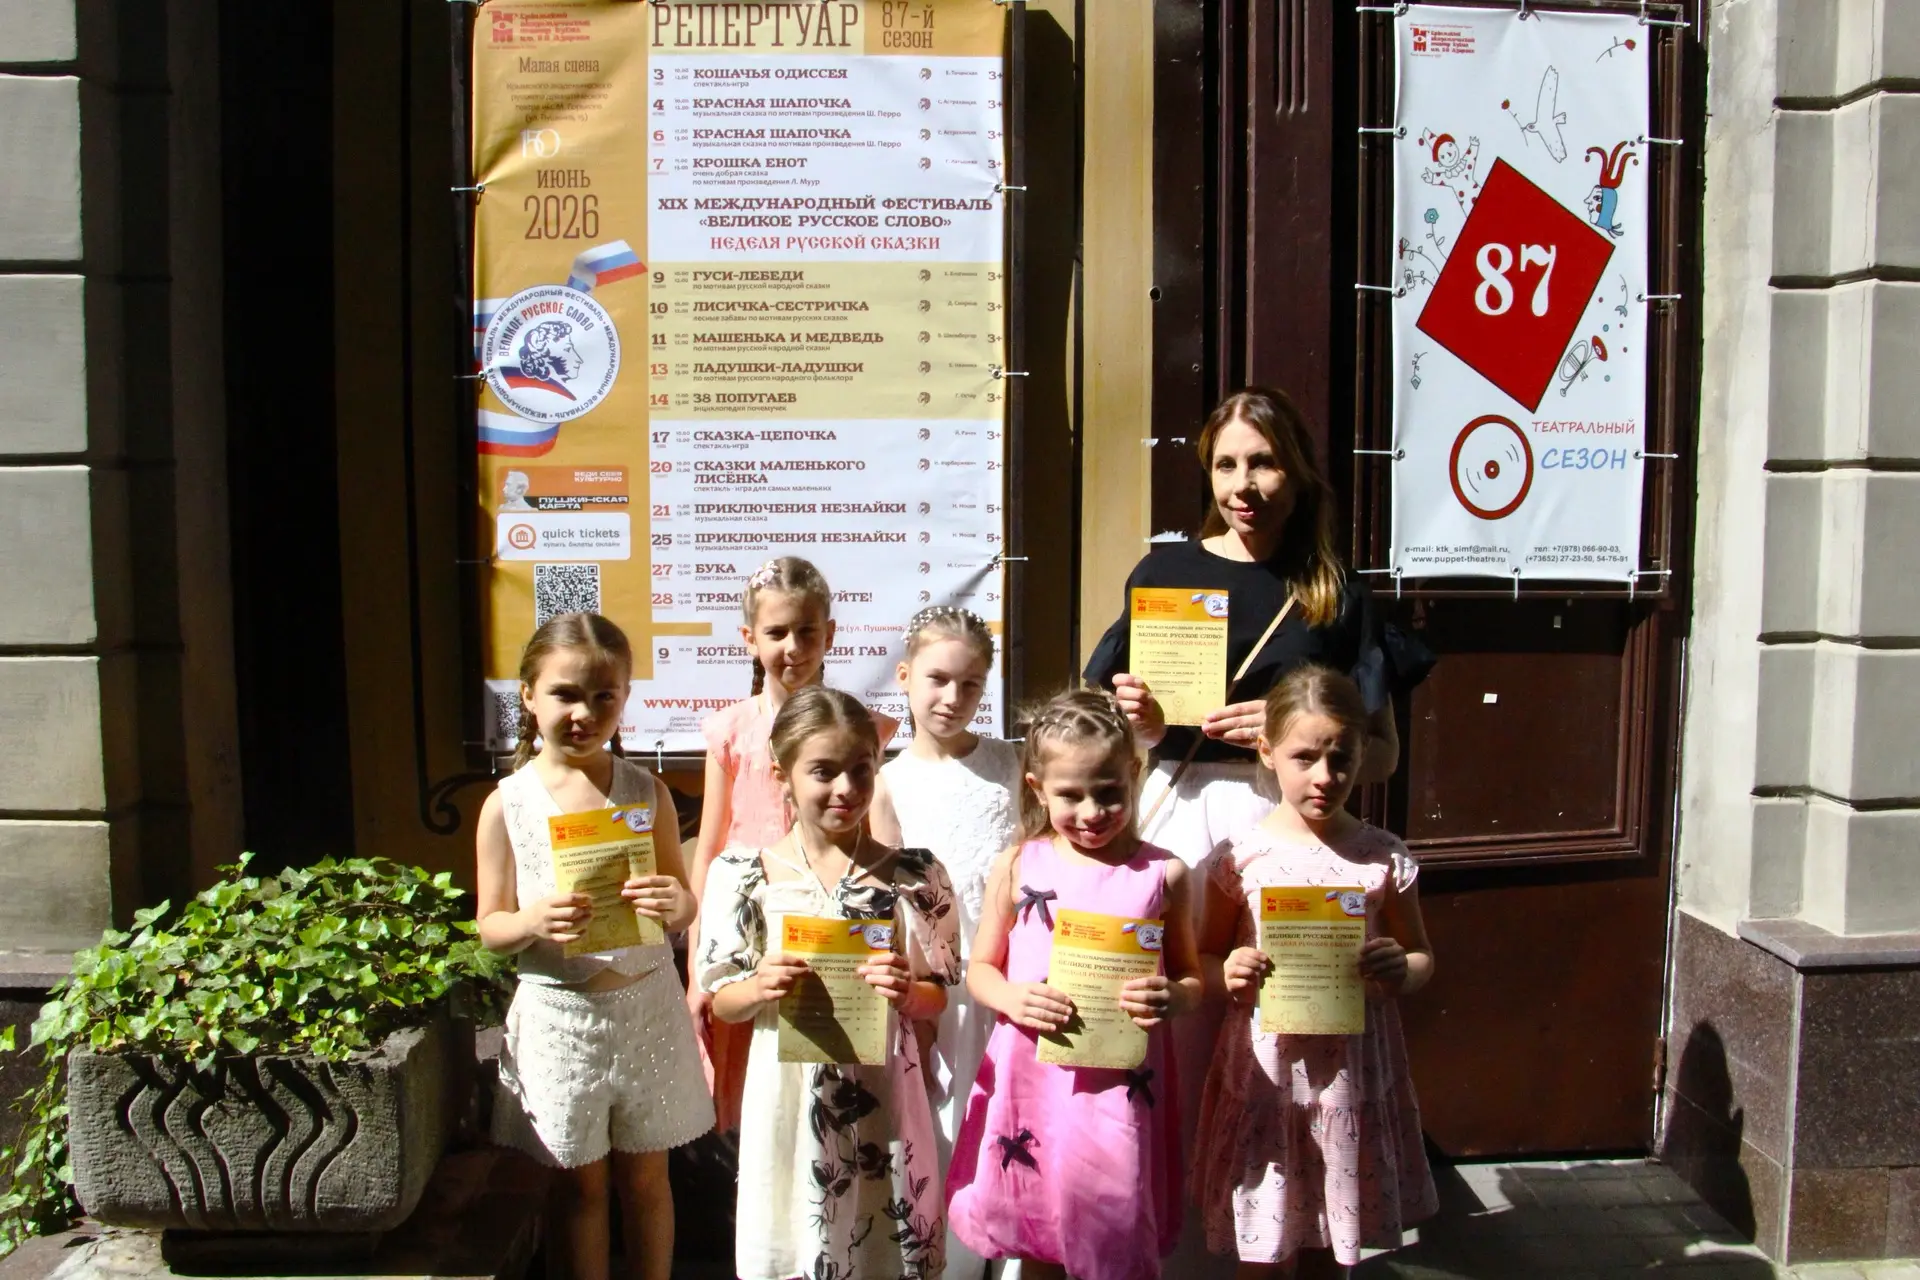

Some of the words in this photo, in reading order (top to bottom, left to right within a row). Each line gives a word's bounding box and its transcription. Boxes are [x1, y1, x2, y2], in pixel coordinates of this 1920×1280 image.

[882, 1, 934, 28] 87-й
[652, 4, 858, 46] РЕПЕРТУАР
[883, 30, 933, 48] сезон
[520, 57, 560, 73] Малая
[564, 59, 600, 75] сцена
[654, 69, 664, 80] 3
[694, 69, 771, 79] КОШАЧЬЯ
[775, 69, 848, 79] ОДИССЕЯ
[989, 71, 1003, 80] 3+
[694, 80, 749, 88] спектакль-игра
[653, 99, 665, 110] 4
[693, 98, 765, 108] КРАСНАЯ
[770, 98, 851, 108] ШАПОЧКА
[988, 100, 1003, 109] 3+
[653, 130, 665, 141] 6
[693, 129, 765, 139] КРАСНАЯ
[770, 129, 851, 139] ШАПОЧКА
[988, 130, 1003, 140] 3+
[654, 158, 664, 170] 7
[693, 158, 761, 168] КРОШКА
[766, 158, 807, 168] ЕНОТ
[988, 160, 1002, 169] 3+
[537, 170, 591, 188] ИЮНЬ
[716, 170, 743, 178] добрая
[800, 178, 820, 186] Муур
[658, 198, 688, 210] XIX
[694, 195, 875, 211] МЕЖДУНАРОДНЫЙ
[882, 198, 993, 211] ФЕСТИВАЛЬ
[524, 194, 599, 240] 2026
[700, 216, 792, 227] «ВЕЛИКОЕ
[798, 216, 879, 227] РУССКОЕ
[885, 216, 952, 227] СЛОВО»
[711, 236, 780, 251] НЕДЕЛЯ
[786, 235, 866, 253] РУССКОЙ
[871, 236, 940, 250] СКАЗКИ
[653, 272, 665, 283] 9
[693, 272, 804, 282] ГУСИ-ЛЕБЕДИ
[988, 272, 1003, 281] 3+
[1474, 243, 1556, 317] 87
[499, 289, 563, 322] МЕЖДУНАРОДНЫЙ
[565, 291, 604, 322] ФЕСТИВАЛЬ
[650, 302, 668, 314] 10
[693, 302, 869, 311] ЛИСИЧКА-СЕСТРИЧКА
[988, 302, 1002, 312] 3+
[499, 316, 524, 356] ВЕЛИКОЕ
[521, 302, 564, 321] РУССКОЕ
[566, 306, 595, 332] СЛОВО
[652, 334, 667, 345] 11
[694, 333, 786, 343] МАШЕНЬКА
[790, 333, 801, 343] И
[806, 333, 884, 343] МЕДВЕДЬ
[988, 334, 1002, 343] 3+
[599, 326, 616, 396] МЕЖДУНАРОДНЫЙ
[650, 364, 668, 375] 13
[694, 363, 863, 373] ЛАДУШКИ-ЛАДУШКИ
[694, 375, 702, 383] по
[704, 375, 736, 383] мотивам
[738, 375, 770, 383] русского
[772, 375, 811, 383] народного
[813, 375, 853, 383] фольклора
[650, 394, 669, 405] 14
[693, 394, 711, 403] 38
[716, 394, 797, 403] ПОПУГАЕВ
[987, 394, 1002, 403] 3+
[555, 394, 599, 418] ФЕСТИВАЛЬ
[1532, 418, 1635, 434] ТЕАТРАЛЬНЫЙ
[652, 432, 670, 443] 17
[694, 431, 836, 442] СКАЗКА-ЦЕПОЧКА
[987, 431, 1001, 440] 3+
[1541, 448, 1627, 470] СЕЗОН
[650, 462, 672, 473] 20
[694, 462, 756, 471] СКАЗКИ
[760, 462, 866, 471] МАЛЕНЬКОГО
[987, 462, 1002, 470] 2+
[694, 472, 768, 484] ЛИСЁНКА
[653, 505, 670, 516] 21
[694, 502, 816, 513] ПРИКЛЮЧЕНИЯ
[821, 502, 906, 513] НЕЗНАЙКИ
[986, 504, 1001, 514] 5+
[542, 528, 575, 539] quick
[580, 528, 620, 538] tickets
[695, 532, 816, 543] ПРИКЛЮЧЕНИЯ
[821, 532, 906, 543] НЕЗНАЙКИ
[986, 534, 1001, 543] 5+
[652, 534, 672, 545] 25
[1405, 545, 1434, 553] e-mail:
[1412, 556, 1506, 564] www.puppet-theatre.ru
[652, 564, 673, 575] 27
[696, 564, 736, 573] БУКА
[652, 594, 673, 605] 28
[696, 593, 742, 603] ТРЯМ!
[986, 593, 1001, 601] 3+
[658, 648, 669, 659] 9
[859, 647, 887, 656] ГАВ
